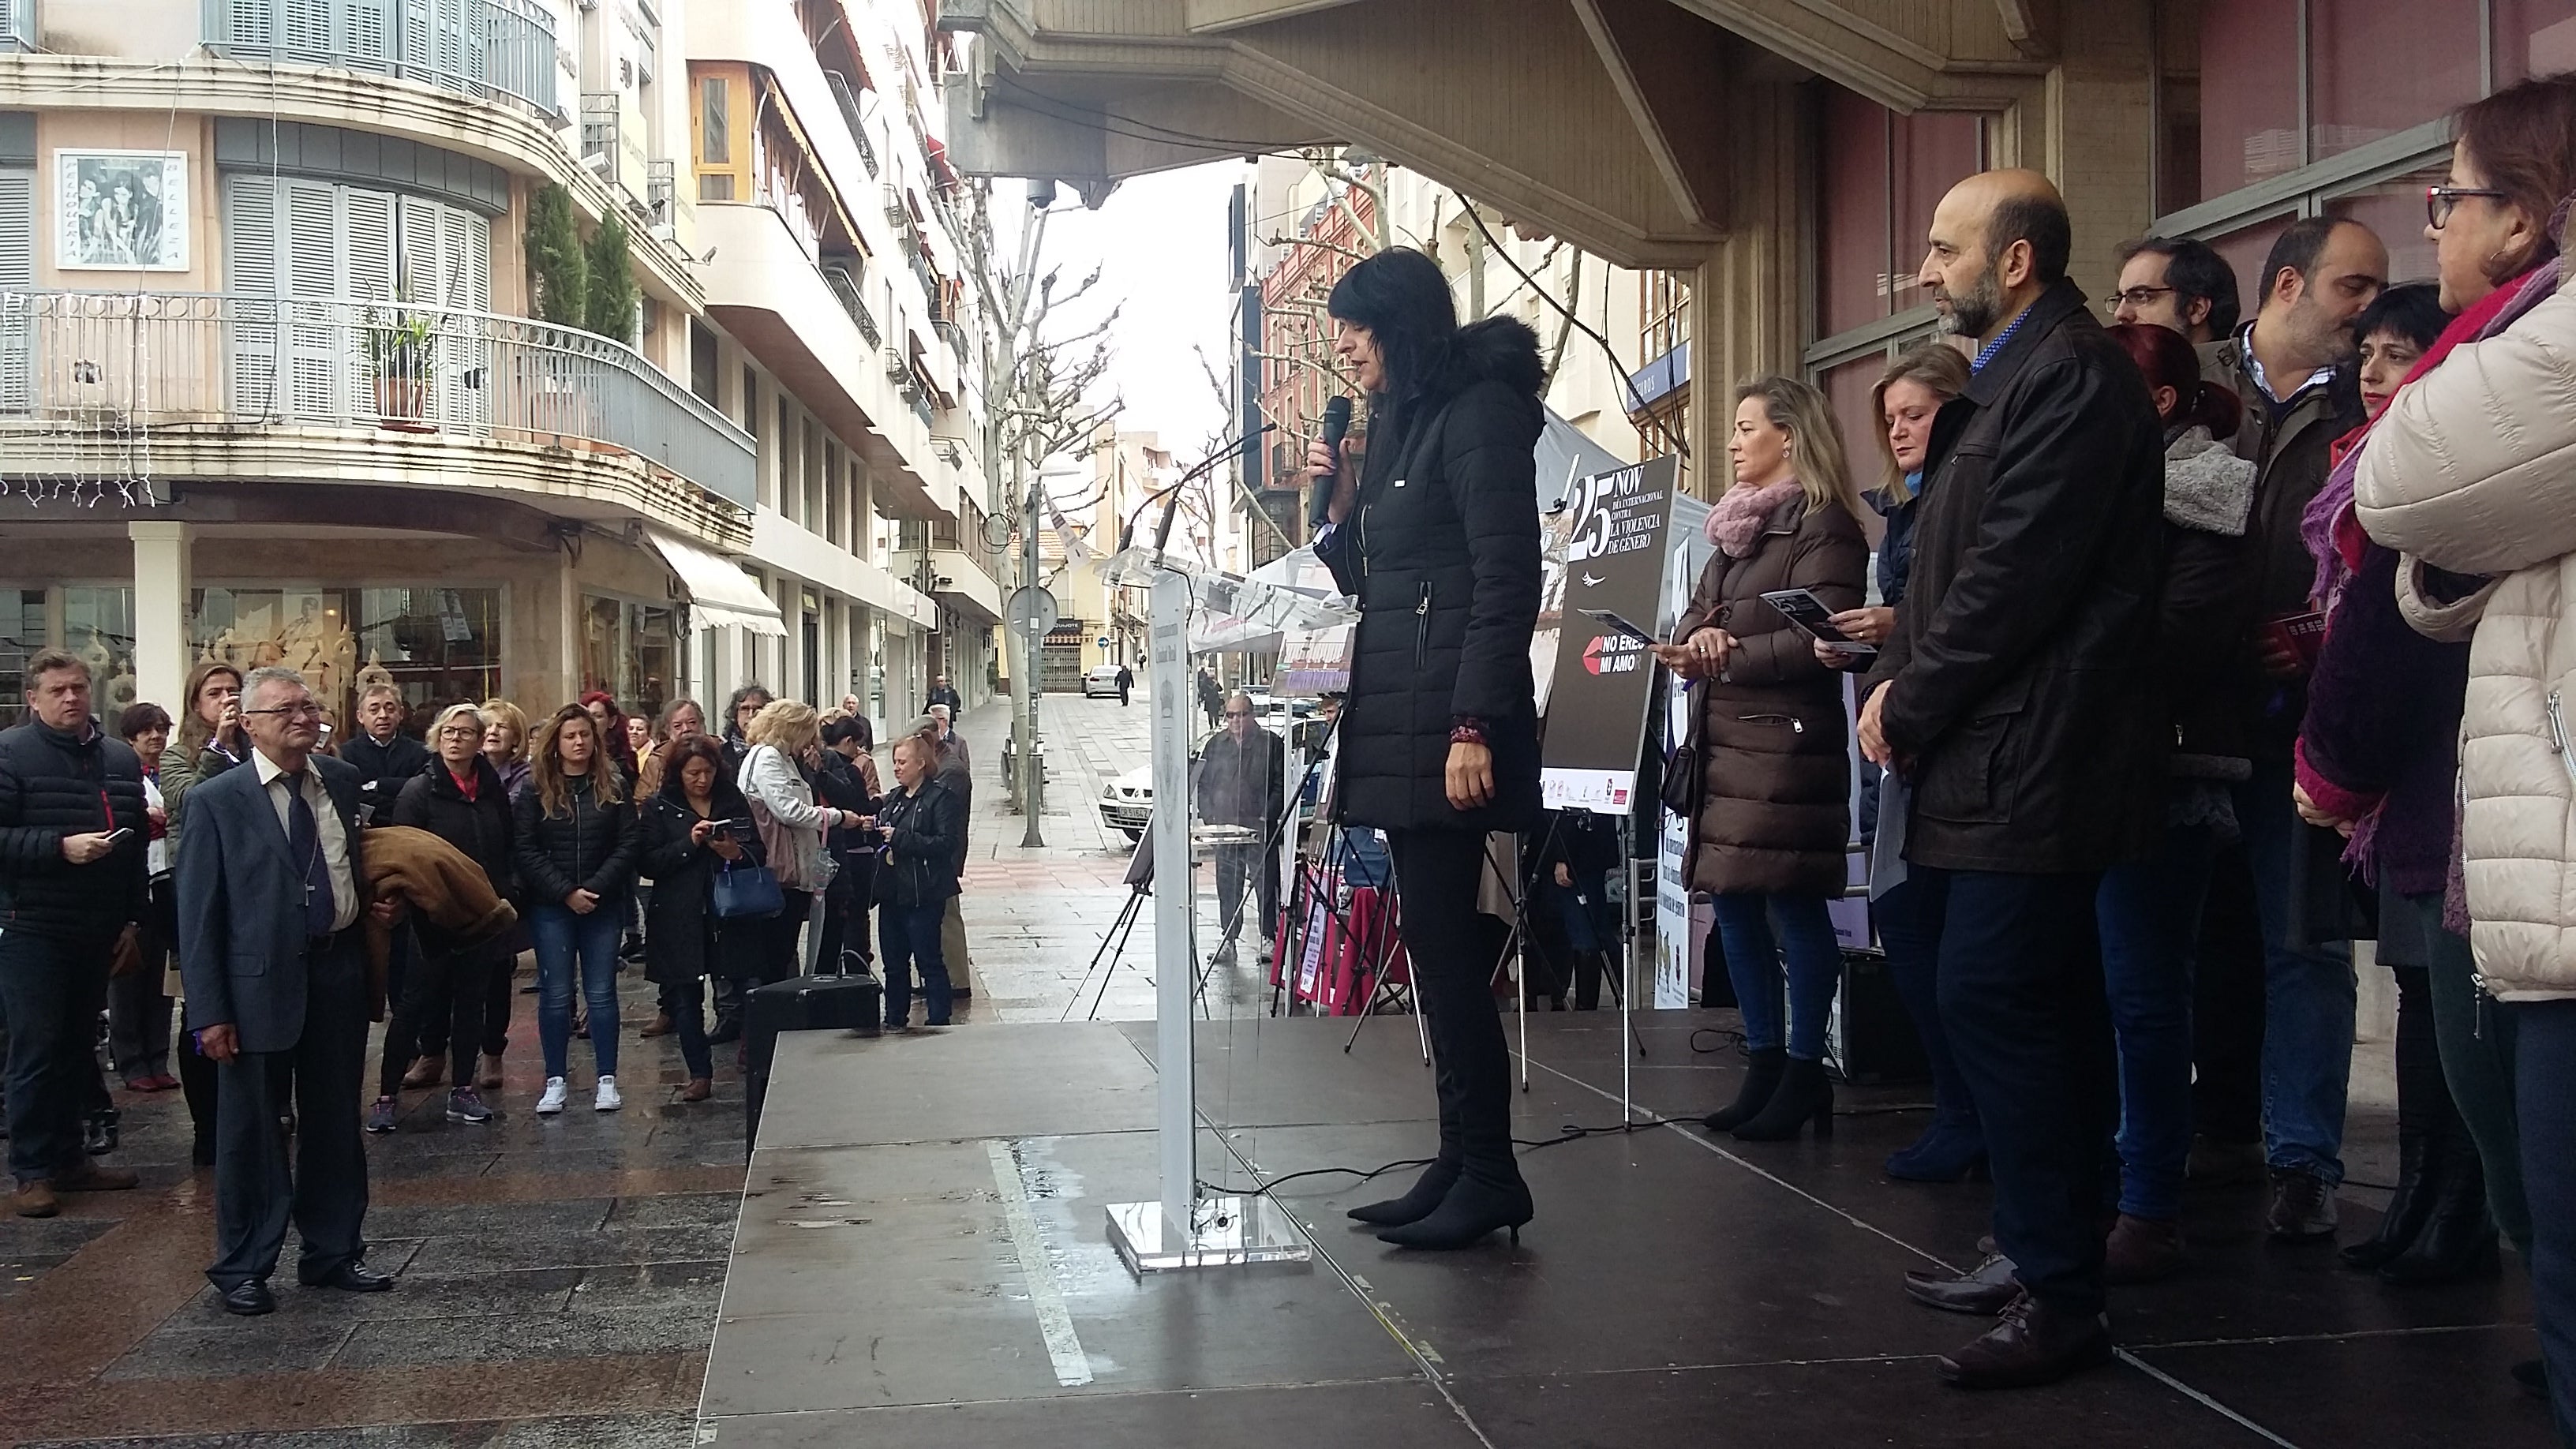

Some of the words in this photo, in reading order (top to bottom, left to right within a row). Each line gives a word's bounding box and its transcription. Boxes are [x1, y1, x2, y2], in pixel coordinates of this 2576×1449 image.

[65, 162, 77, 257] PELUQUERIA
[166, 163, 179, 259] BELLEZA
[1613, 465, 1645, 499] NOV
[1622, 489, 1664, 507] INTERNACIONAL
[1567, 473, 1615, 560] 25
[1610, 522, 1619, 537] LA
[1621, 513, 1661, 534] VIOLENCIA
[1611, 508, 1631, 522] CONTRA
[1608, 539, 1619, 555] DE
[1619, 533, 1651, 553] GÉNERO
[1602, 635, 1618, 653] NO
[1599, 656, 1612, 673] MI
